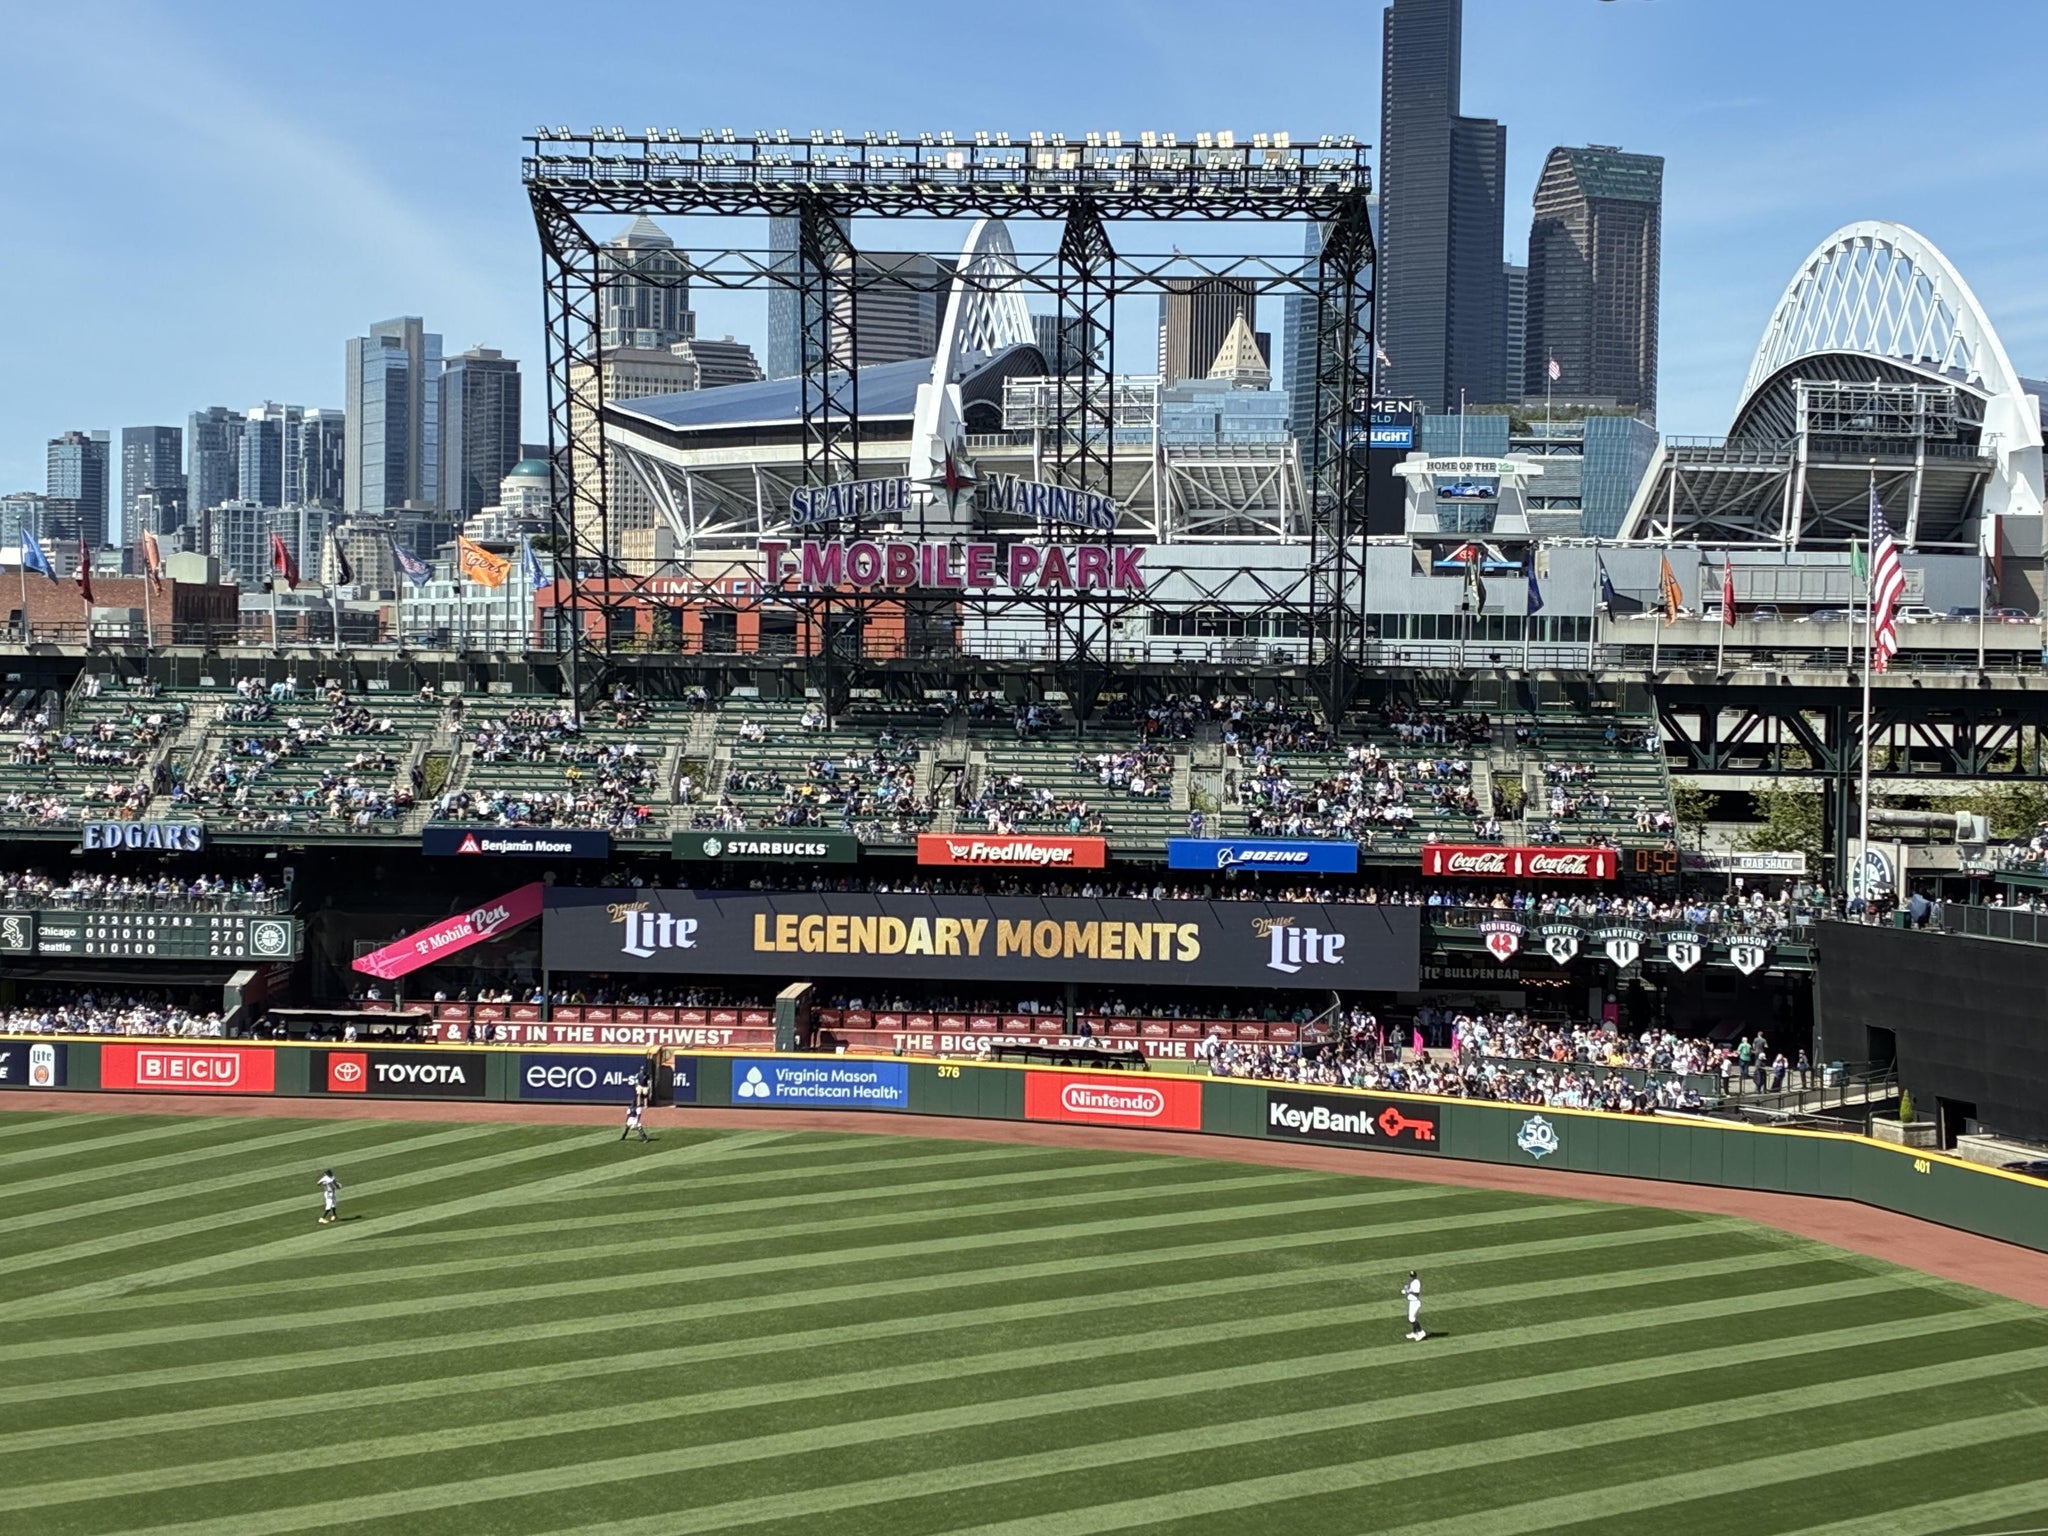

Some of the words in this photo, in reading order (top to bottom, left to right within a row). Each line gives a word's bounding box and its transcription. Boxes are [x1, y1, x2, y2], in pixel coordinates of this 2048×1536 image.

[1371, 432, 1408, 442] LIGHT
[1427, 462, 1457, 471] HOME
[1459, 463, 1473, 471] OF
[1475, 463, 1496, 472] THE
[790, 476, 912, 526] SEATTLE
[984, 472, 1119, 531] MARINERS
[757, 540, 999, 590] T-MOBILE
[1006, 541, 1148, 591] PARK
[481, 840, 533, 853] Benjamin
[535, 841, 573, 852] Moore
[727, 841, 827, 855] STARBUCKS
[1239, 850, 1309, 862] BOEING
[1448, 852, 1509, 874] Coca-Cola
[1529, 853, 1588, 875] Coca-Cola
[1636, 850, 1677, 873] 0:52
[1741, 858, 1763, 869] CRAB
[1765, 858, 1793, 870] SHACK
[88, 915, 93, 924] 1
[99, 916, 106, 924] 2
[111, 916, 118, 924] 3
[123, 916, 130, 924] 4
[136, 917, 142, 925] 5
[147, 917, 155, 925] 6
[160, 917, 167, 925] 7
[172, 917, 180, 926] 8
[185, 918, 192, 926] 9
[211, 918, 219, 927] R
[223, 919, 232, 927] H
[236, 919, 244, 927] E
[606, 901, 649, 923] Miller
[38, 927, 76, 938] Chicago
[86, 928, 93, 938] 0
[98, 928, 106, 938] 0
[112, 929, 117, 939] 1
[122, 928, 130, 938] 0
[136, 929, 141, 939] 1
[147, 929, 155, 939] 0
[211, 931, 219, 941] 2
[223, 931, 231, 941] 7
[236, 931, 244, 941] 0
[428, 924, 473, 950] Mobile
[621, 911, 698, 958] Lite
[1251, 916, 1296, 938] Miller
[1480, 923, 1522, 935] ROBINSON
[1542, 926, 1579, 936] GRIFFEY
[1599, 930, 1644, 942] MARTINEZ
[754, 914, 989, 956] LEGENDARY
[997, 919, 1201, 962] MOMENTS
[1491, 934, 1512, 954] 42
[1551, 938, 1573, 957] 24
[1667, 933, 1699, 943] ICHIRO
[1725, 937, 1768, 948] JOHNSON
[38, 942, 72, 952] Seattle
[86, 943, 93, 953] 0
[100, 943, 105, 953] 1
[111, 943, 118, 953] 0
[124, 943, 129, 953] 1
[135, 944, 142, 954] 0
[147, 944, 155, 954] 0
[211, 945, 219, 955] 2
[223, 945, 231, 956] 4
[236, 946, 244, 956] 0
[1267, 926, 1345, 974] Lite
[1615, 941, 1630, 961] 11
[1674, 944, 1693, 965] 51
[1737, 948, 1757, 968] 51
[1444, 968, 1494, 980] BULLPEN
[1497, 968, 1520, 980] BAR
[526, 1026, 548, 1041] IN
[553, 1026, 595, 1042] THE
[600, 1028, 733, 1046] NORTHWEST
[893, 1034, 933, 1050] THE
[1145, 1041, 1187, 1057] THE
[33, 1050, 51, 1064] Lite
[145, 1059, 232, 1079] BECU
[375, 1064, 466, 1084] TOYOTA
[526, 1065, 597, 1089] eero
[776, 1068, 828, 1084] Virginia
[832, 1070, 877, 1083] Mason
[938, 1066, 960, 1078] 376
[776, 1084, 854, 1098] Franciscan
[859, 1085, 898, 1100] Health
[1070, 1090, 1154, 1110] Nintendo
[1270, 1103, 1375, 1134] KeyBank
[1525, 1123, 1552, 1143] 50
[1914, 1158, 1931, 1174] 401
